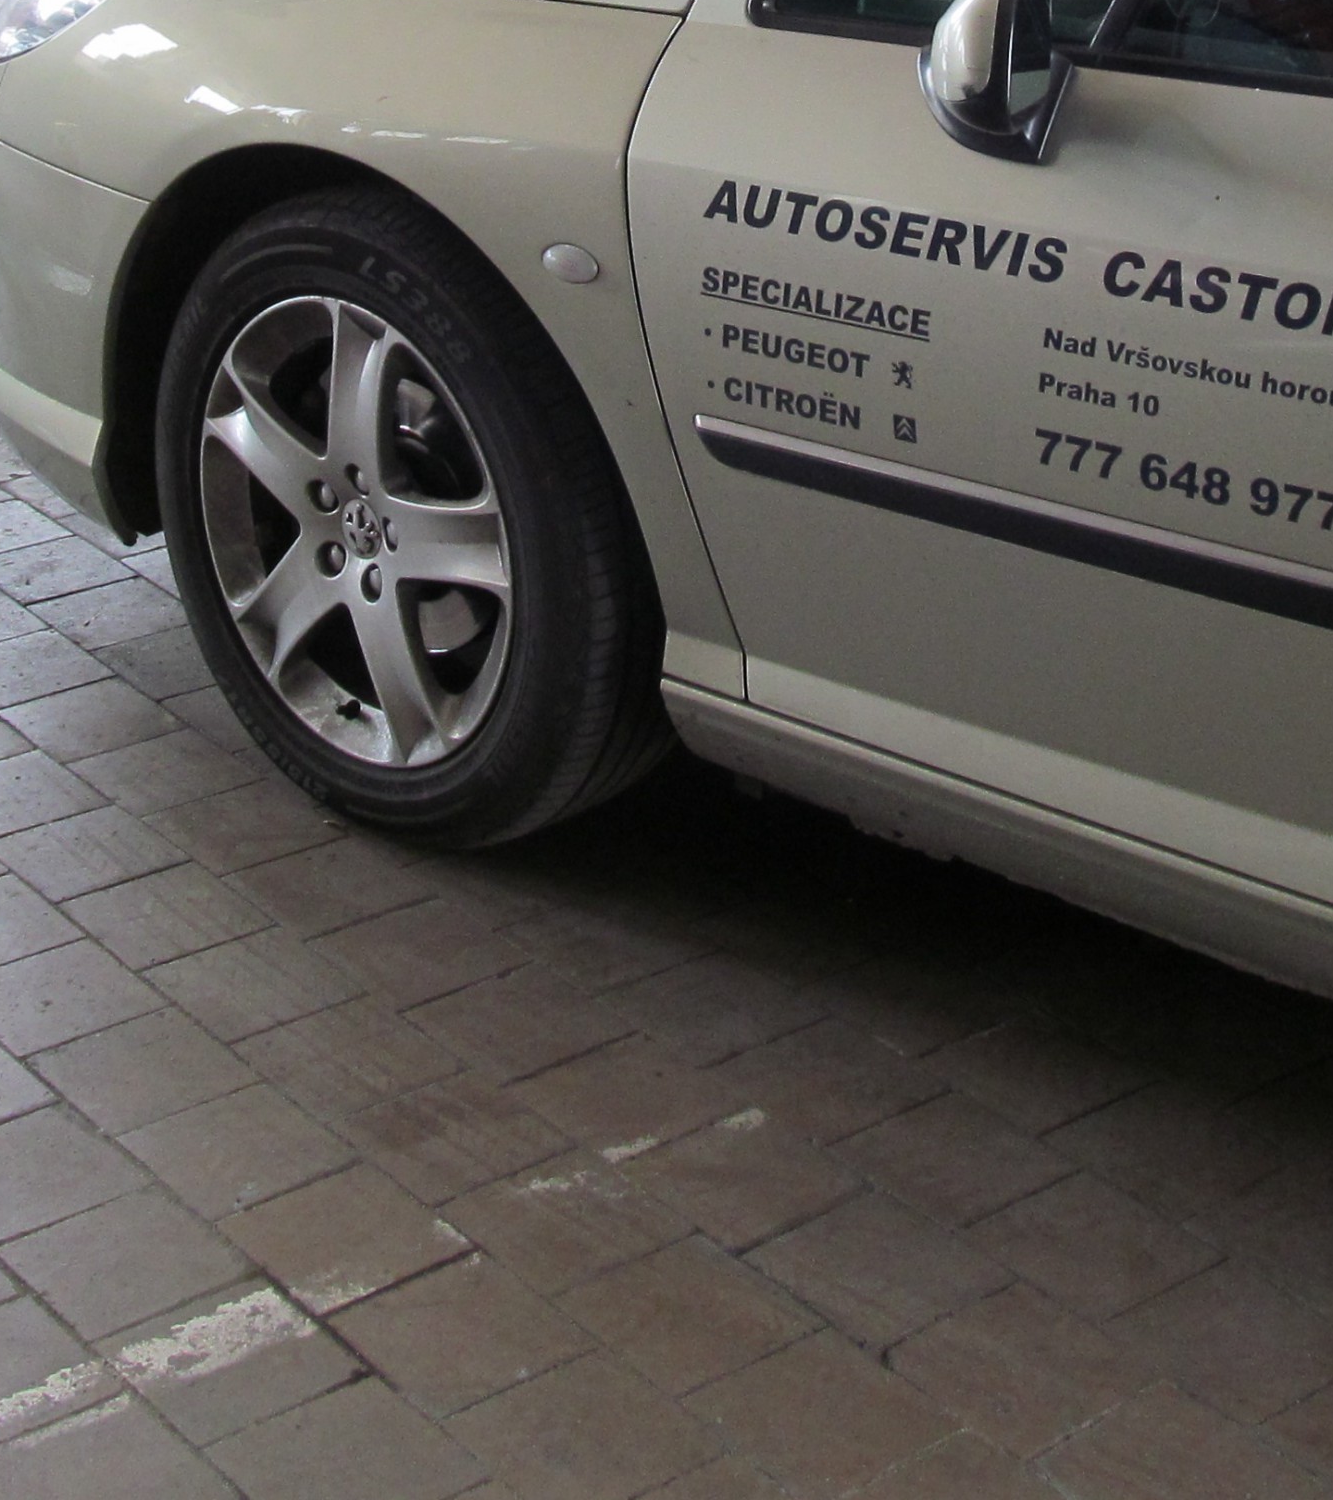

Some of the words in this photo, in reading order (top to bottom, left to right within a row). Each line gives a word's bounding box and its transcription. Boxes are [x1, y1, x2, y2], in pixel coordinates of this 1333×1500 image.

[702, 179, 1068, 284] AUTOSERVIS
[700, 265, 932, 339] SPECIALIZACE
[721, 323, 871, 379] PEUGEOT
[1042, 327, 1098, 358] Nad
[1106, 339, 1252, 390] Vršovskou
[723, 376, 862, 431] CITROËN
[1038, 371, 1117, 409] Praha
[1127, 391, 1160, 418] 10
[1035, 427, 1124, 480] 777
[1139, 452, 1231, 506] 648
